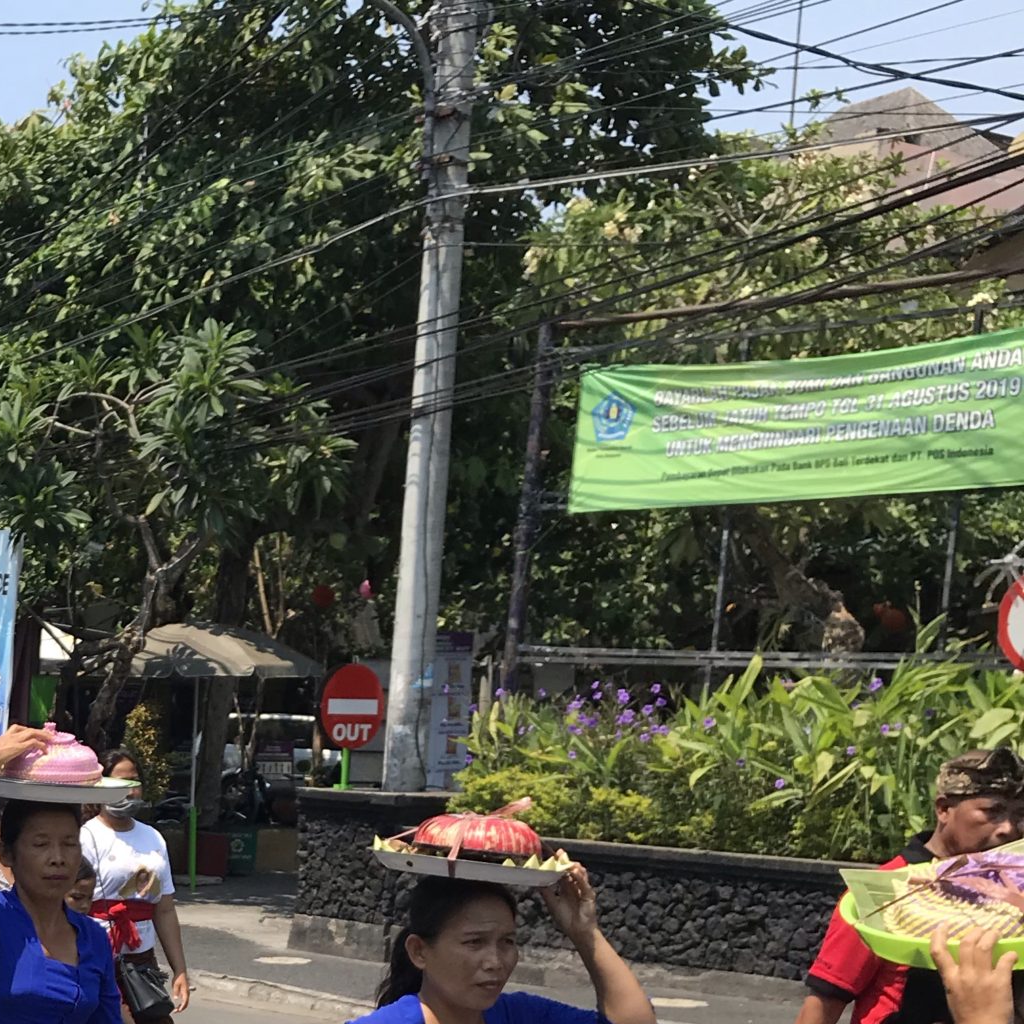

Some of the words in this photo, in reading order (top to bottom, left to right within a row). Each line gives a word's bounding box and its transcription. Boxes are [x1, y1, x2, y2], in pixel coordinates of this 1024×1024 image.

[970, 347, 1023, 370] ANDA
[652, 411, 717, 433] SEBELUM
[864, 394, 884, 411] 31
[888, 381, 971, 409] AGUSTUS
[976, 376, 1022, 400] 2019
[665, 437, 713, 458] UNTUK
[716, 425, 821, 453] MENGHINDARI
[827, 415, 928, 443] PENGENAAN
[932, 408, 996, 434] DENDA
[332, 723, 372, 741] OUT
